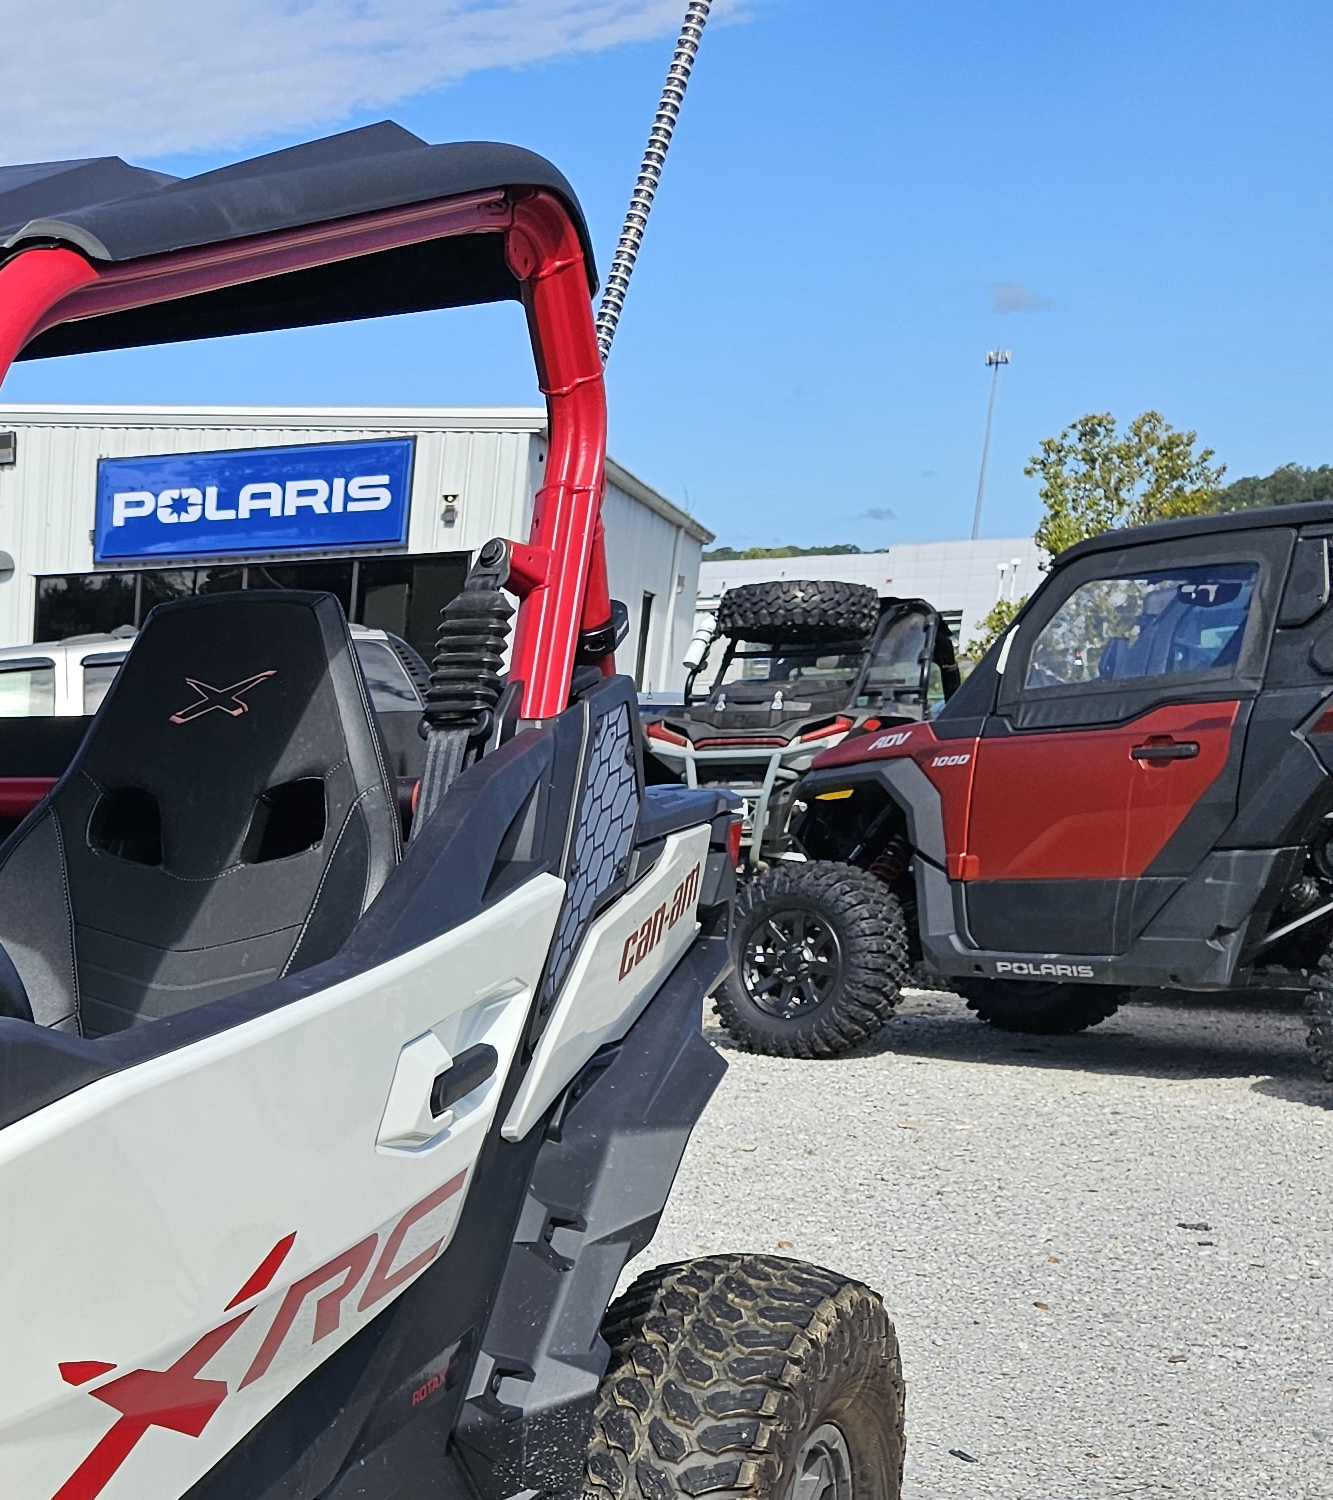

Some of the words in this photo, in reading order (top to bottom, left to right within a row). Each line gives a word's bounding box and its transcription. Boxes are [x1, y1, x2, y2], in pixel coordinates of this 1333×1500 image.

[112, 474, 392, 527] POLARIS
[867, 731, 913, 751] ADV
[931, 754, 971, 767] 1000
[618, 861, 700, 981] can-am
[996, 961, 1094, 978] POLARIS
